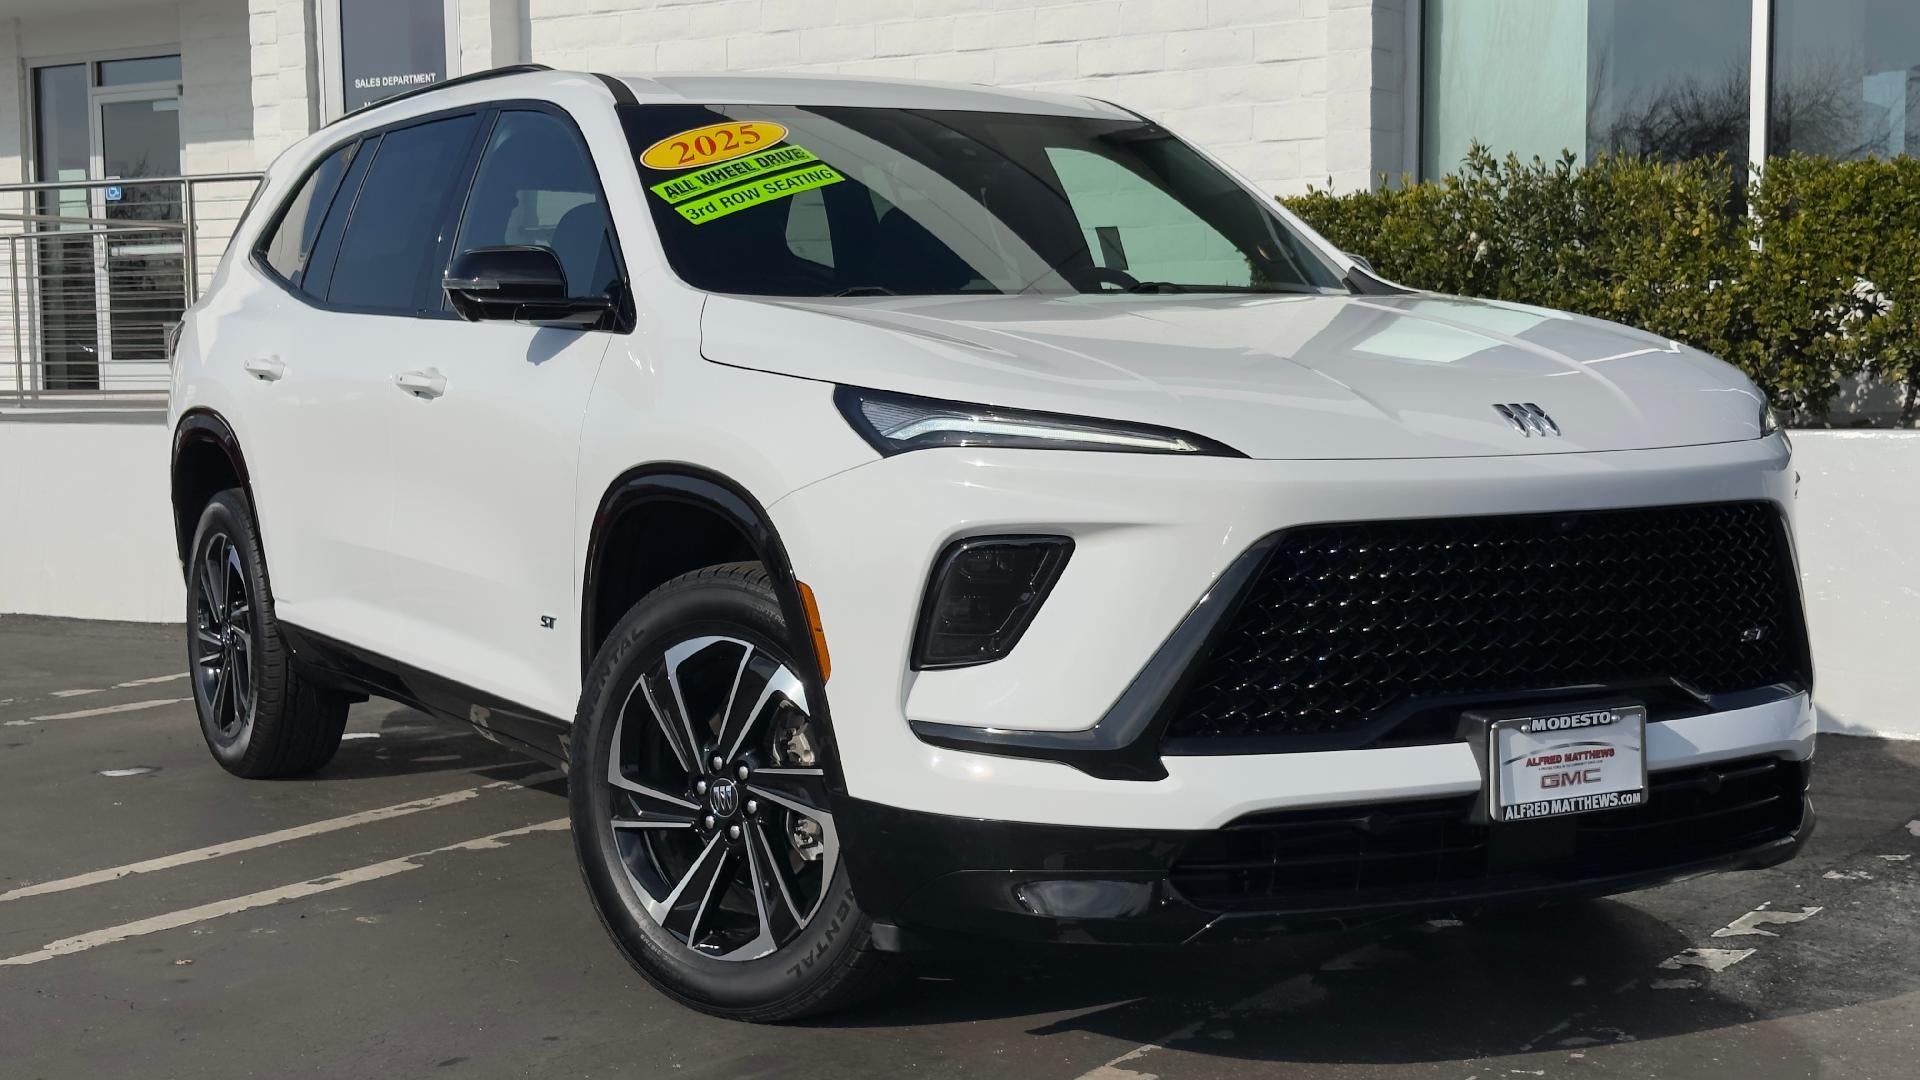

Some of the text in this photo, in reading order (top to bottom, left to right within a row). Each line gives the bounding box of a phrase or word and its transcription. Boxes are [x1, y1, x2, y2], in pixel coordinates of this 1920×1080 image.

[355, 72, 437, 89] SALES DEPARTMENT
[670, 124, 761, 165] 2025
[663, 148, 806, 199] ALL WHEEL DRIVE
[685, 168, 834, 220] 3rd ROW SEATING
[1531, 711, 1611, 732] MODESTO
[1526, 754, 1563, 768] ALFRED
[1564, 748, 1615, 763] MATTHEWS
[1540, 768, 1602, 790] GMC
